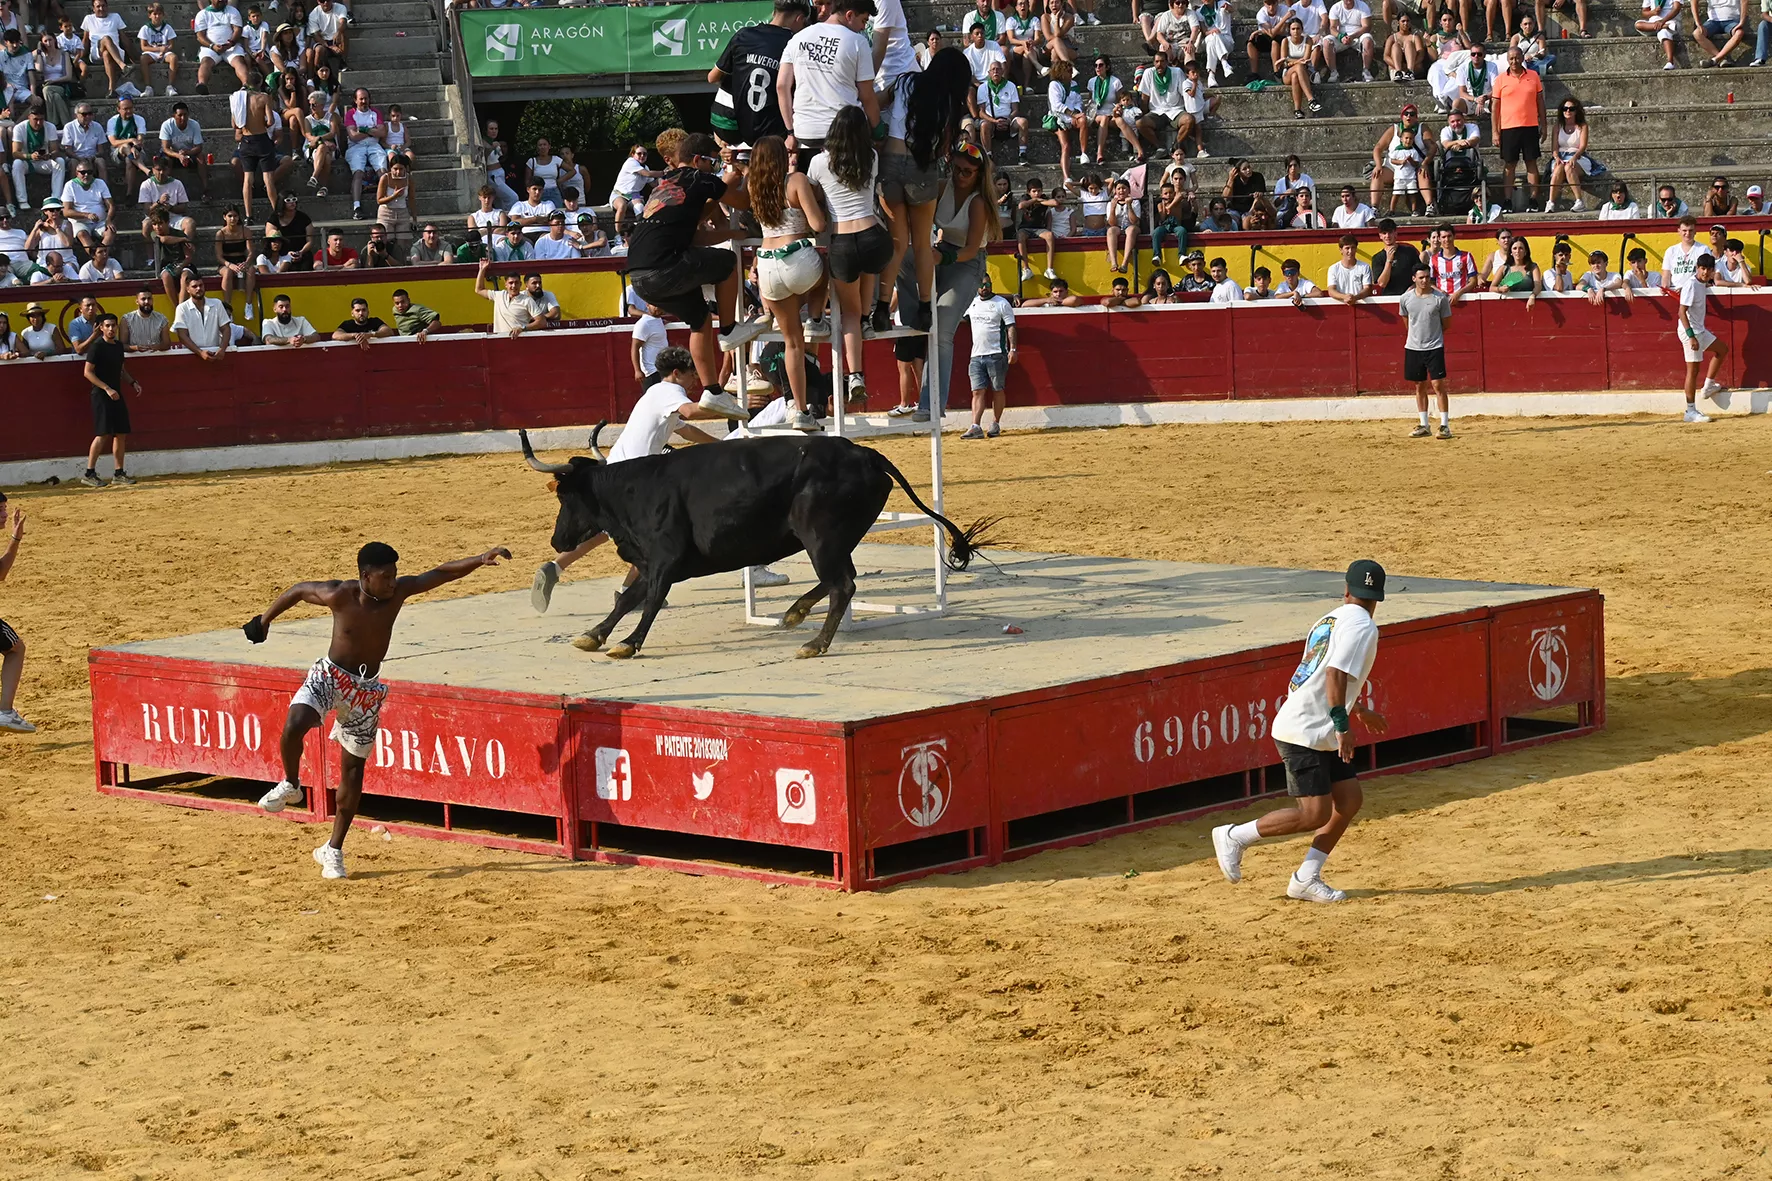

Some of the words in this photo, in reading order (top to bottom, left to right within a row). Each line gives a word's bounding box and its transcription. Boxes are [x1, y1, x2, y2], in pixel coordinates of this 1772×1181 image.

[531, 23, 604, 39] ARAGÓN
[698, 38, 719, 50] TV
[799, 42, 837, 55] NORTH
[819, 36, 840, 47] THE
[531, 44, 553, 55] TV
[746, 53, 780, 70] VALVERD
[808, 52, 835, 65] FACE
[747, 67, 771, 112] 8
[1364, 572, 1374, 586] LA
[141, 703, 262, 751] RUEDO
[375, 728, 506, 779] BRAVO
[664, 735, 693, 758] PATENTE
